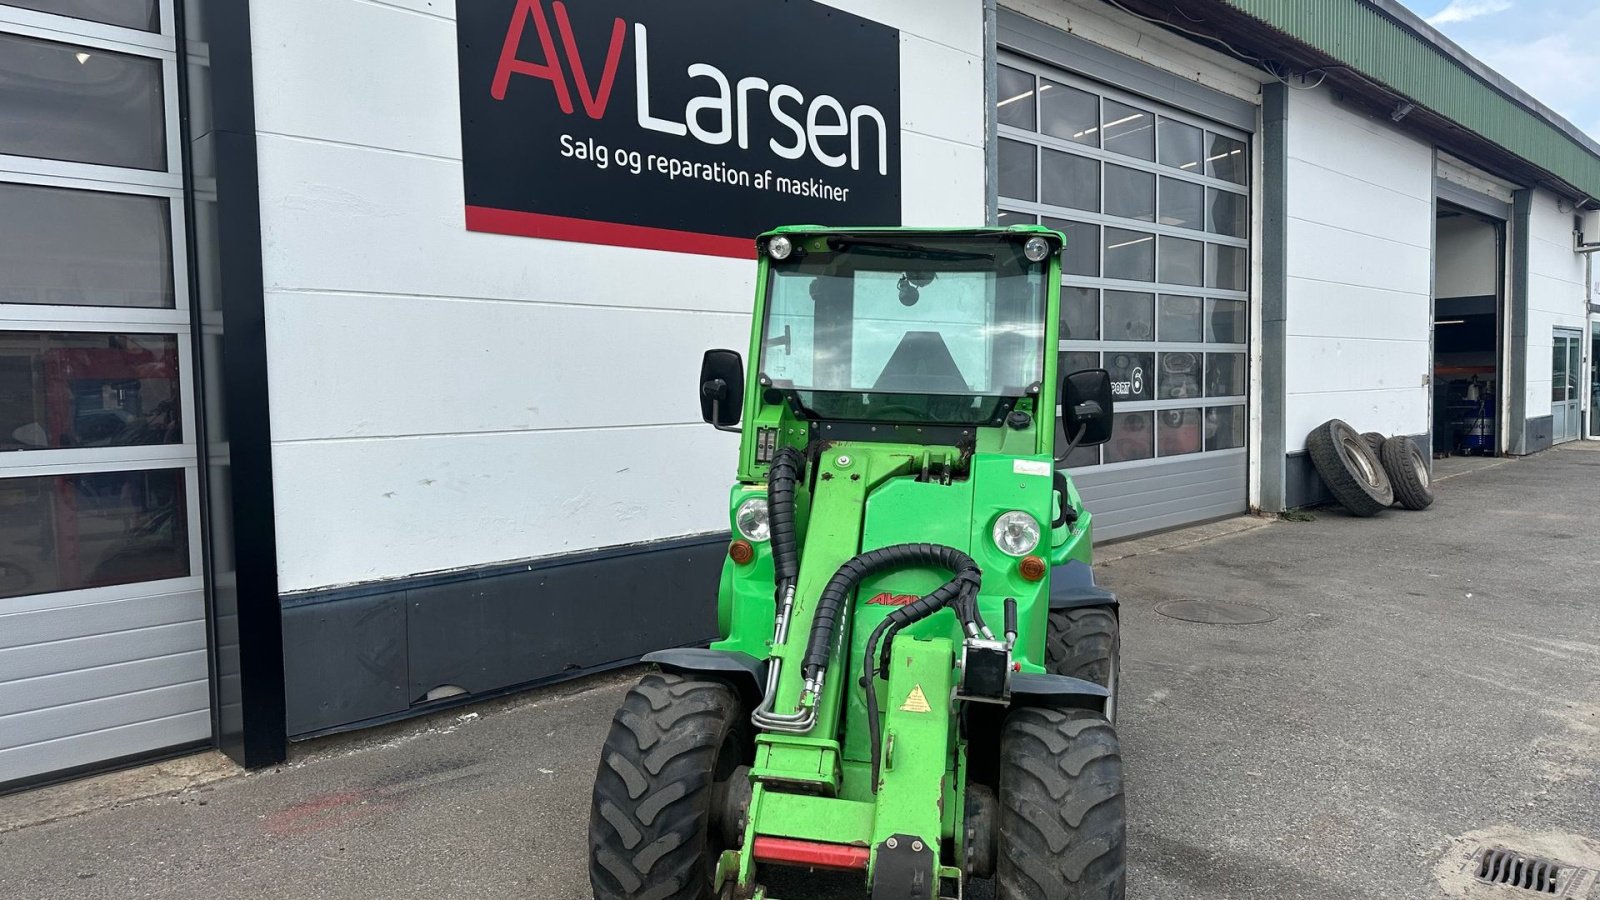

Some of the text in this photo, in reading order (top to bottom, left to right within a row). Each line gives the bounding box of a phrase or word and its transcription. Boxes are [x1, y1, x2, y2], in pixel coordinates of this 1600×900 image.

[560, 134, 850, 202] Salg og reparation af maskiner
[1110, 366, 1144, 395] PORT 6
